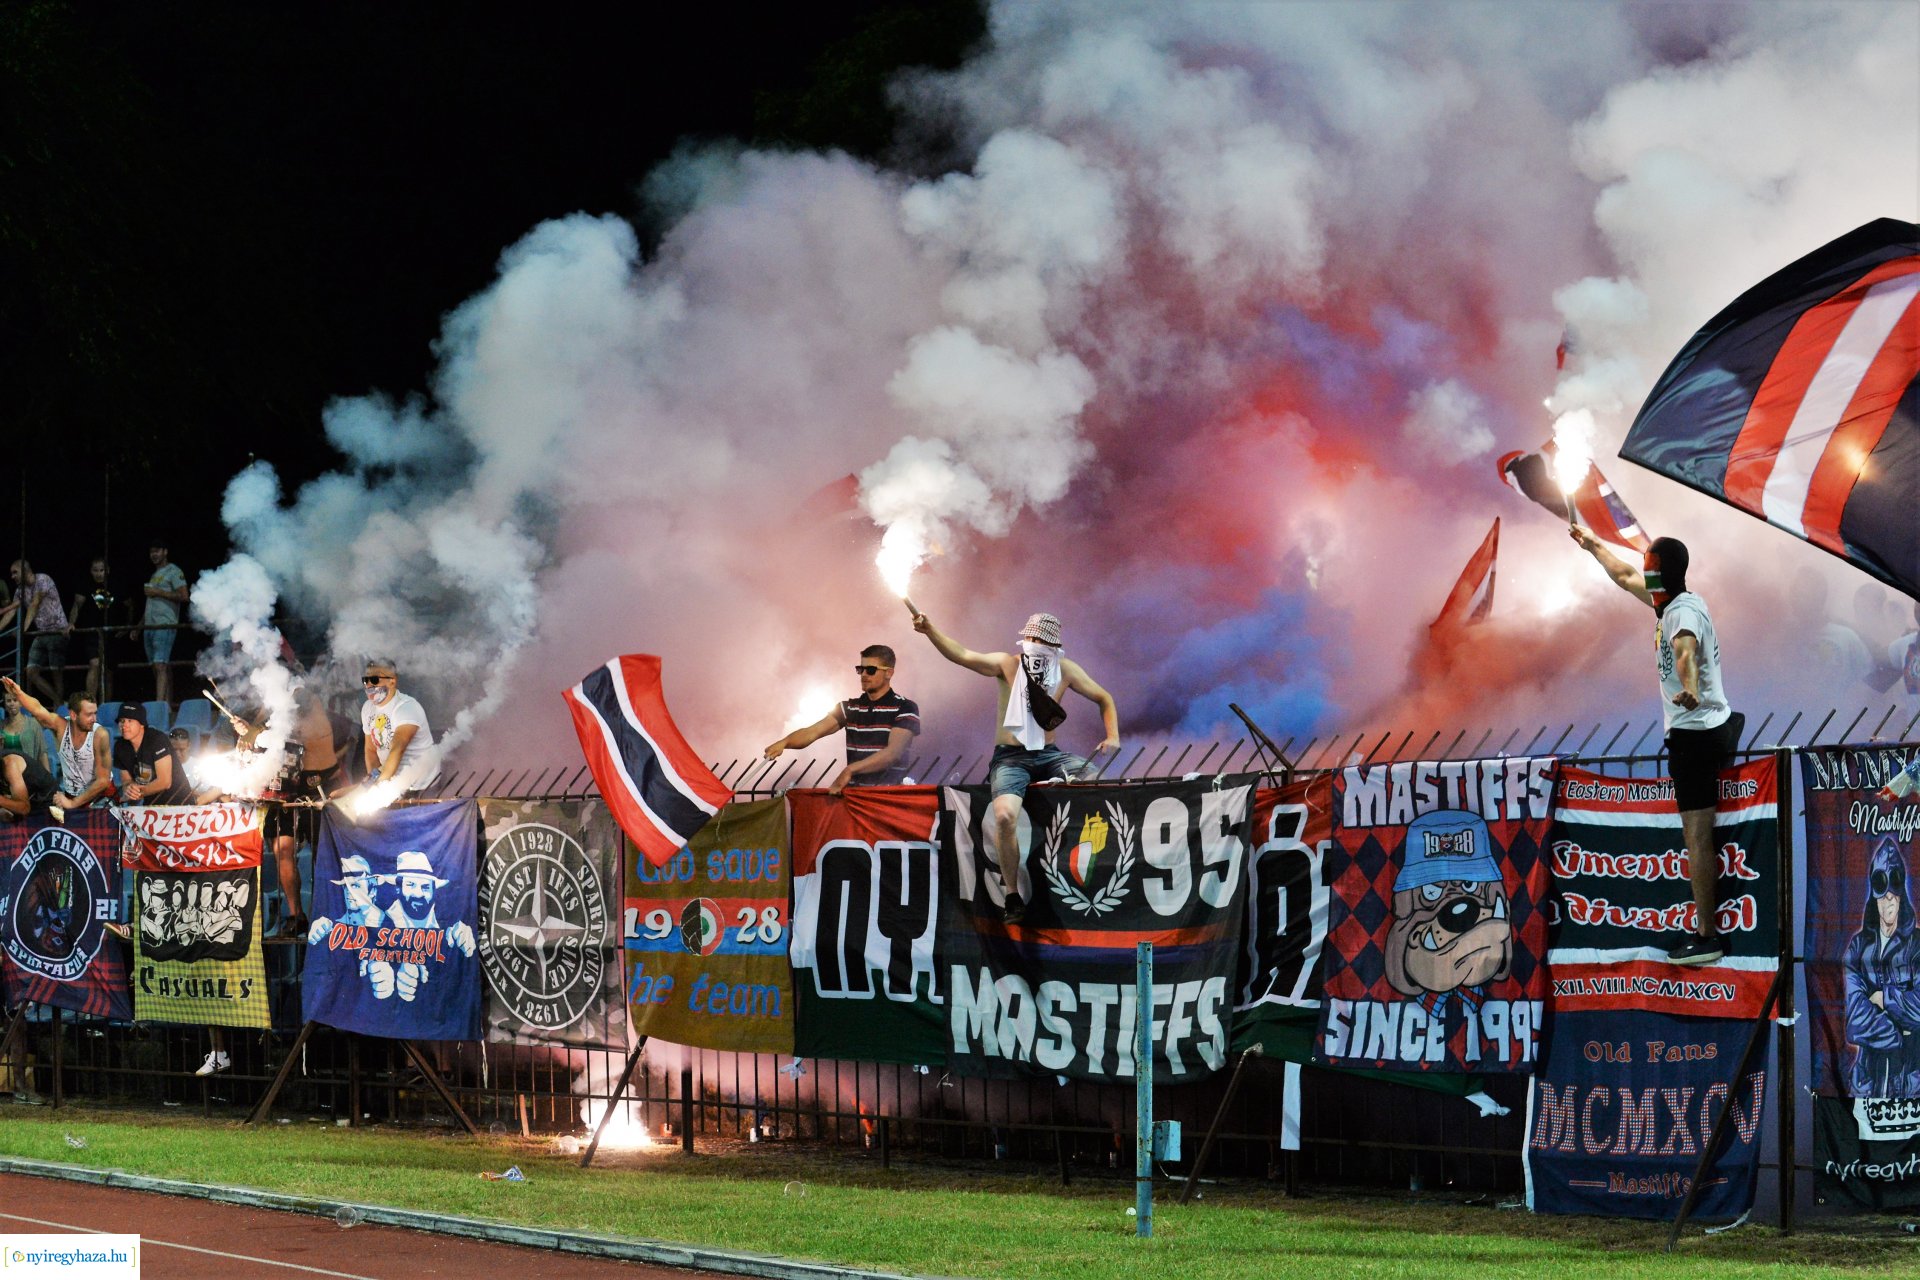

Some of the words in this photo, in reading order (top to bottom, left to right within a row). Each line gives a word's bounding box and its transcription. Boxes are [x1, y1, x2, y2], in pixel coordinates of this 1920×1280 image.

[1805, 747, 1920, 790] MCMX
[1342, 757, 1555, 828] MASTIFFS
[1567, 780, 1624, 803] Eastern
[1723, 778, 1758, 799] Fans
[51, 831, 96, 874] FANS
[155, 840, 245, 868] POLSKA
[520, 831, 554, 853] 1928
[707, 847, 782, 884] save
[328, 922, 369, 951] OLD
[376, 927, 446, 963] SCHOOL
[577, 864, 604, 988] SPARTACUS
[624, 907, 674, 940] 19
[736, 906, 783, 944] 28
[358, 948, 427, 965] FIGHTERS
[524, 1000, 562, 1024] 1928
[688, 972, 783, 1018] team
[950, 964, 1227, 1077] MASTIFFS
[1324, 996, 1447, 1063] SINCE
[1583, 1041, 1633, 1063] Old
[1645, 1041, 1719, 1063] Fans
